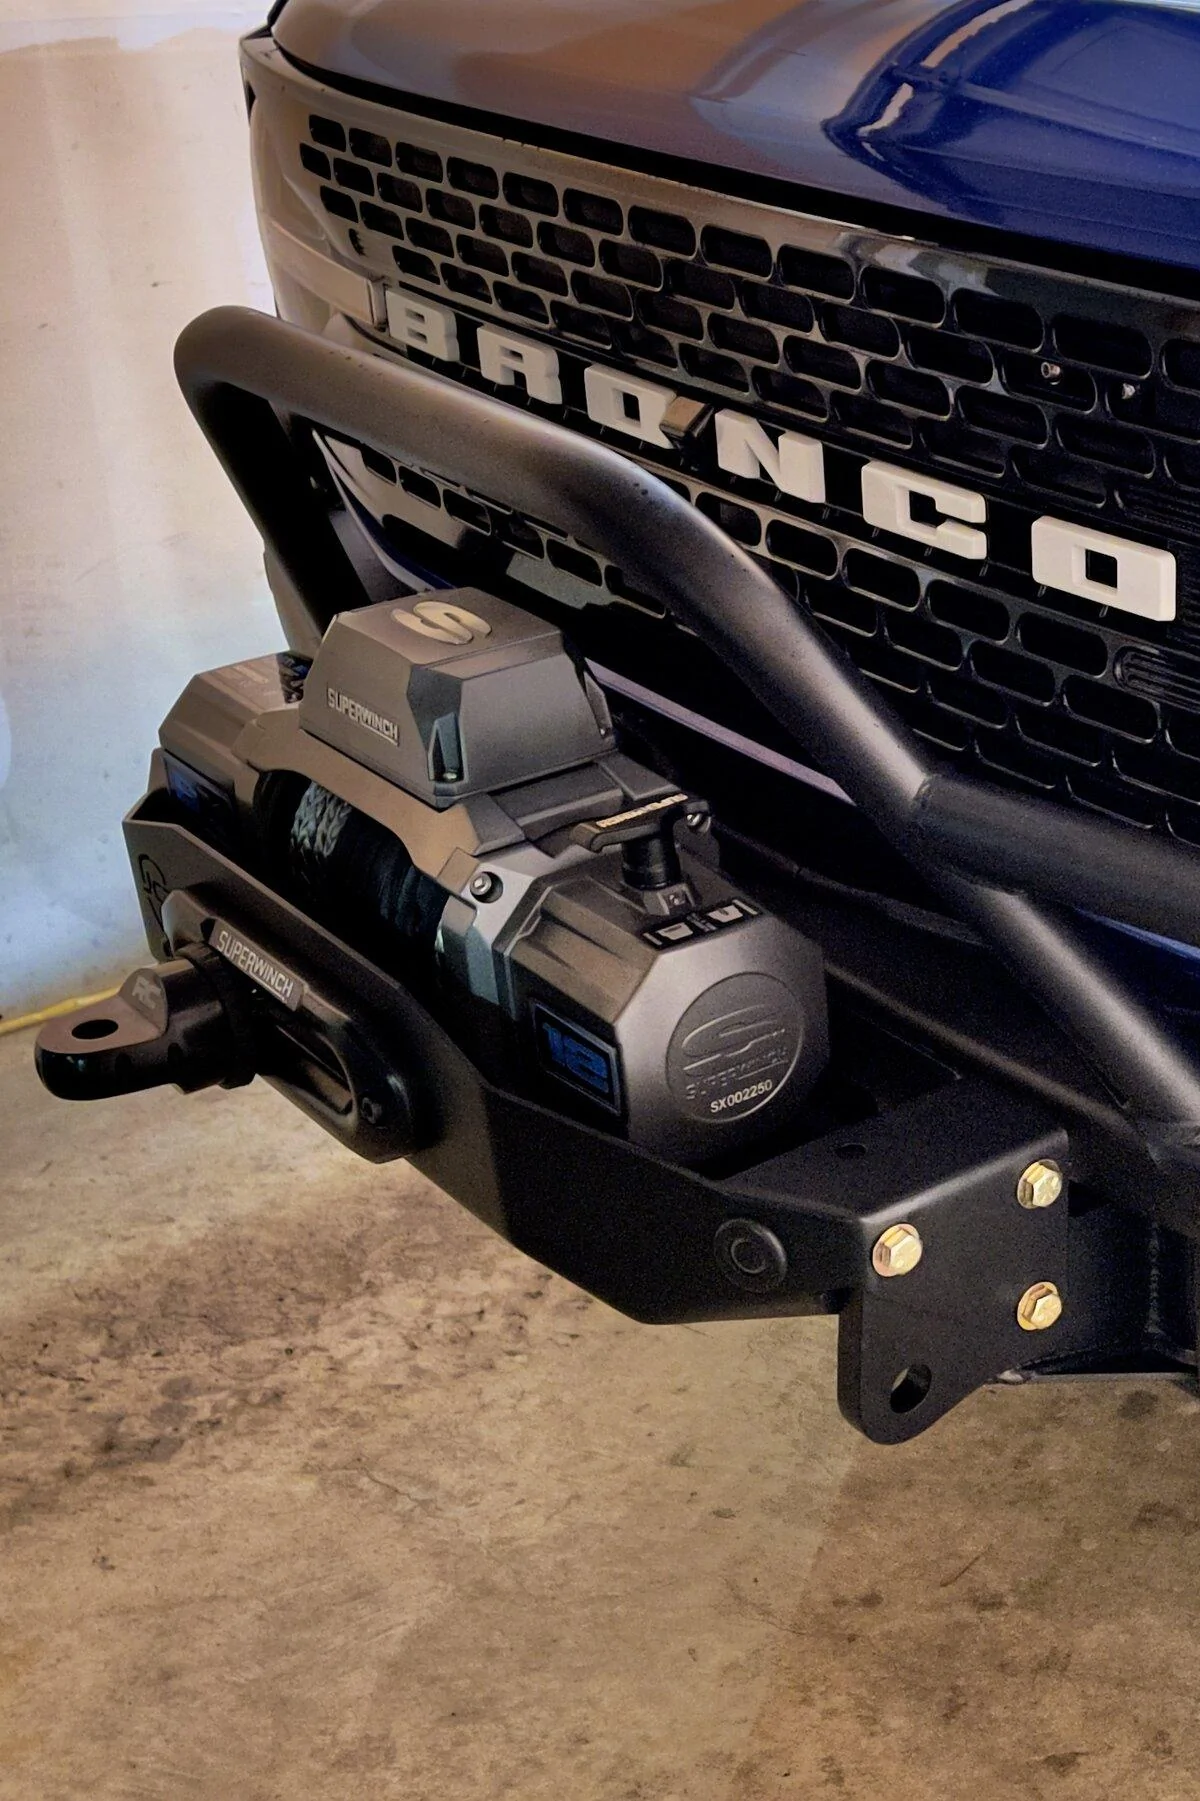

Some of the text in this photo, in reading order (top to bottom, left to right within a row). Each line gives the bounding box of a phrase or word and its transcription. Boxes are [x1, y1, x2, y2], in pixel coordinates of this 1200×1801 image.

[387, 291, 1176, 622] BRONCO
[327, 688, 399, 745] SUPERWINCH
[217, 931, 294, 1000] SUPERWINCH
[710, 1079, 773, 1113] SX002250
